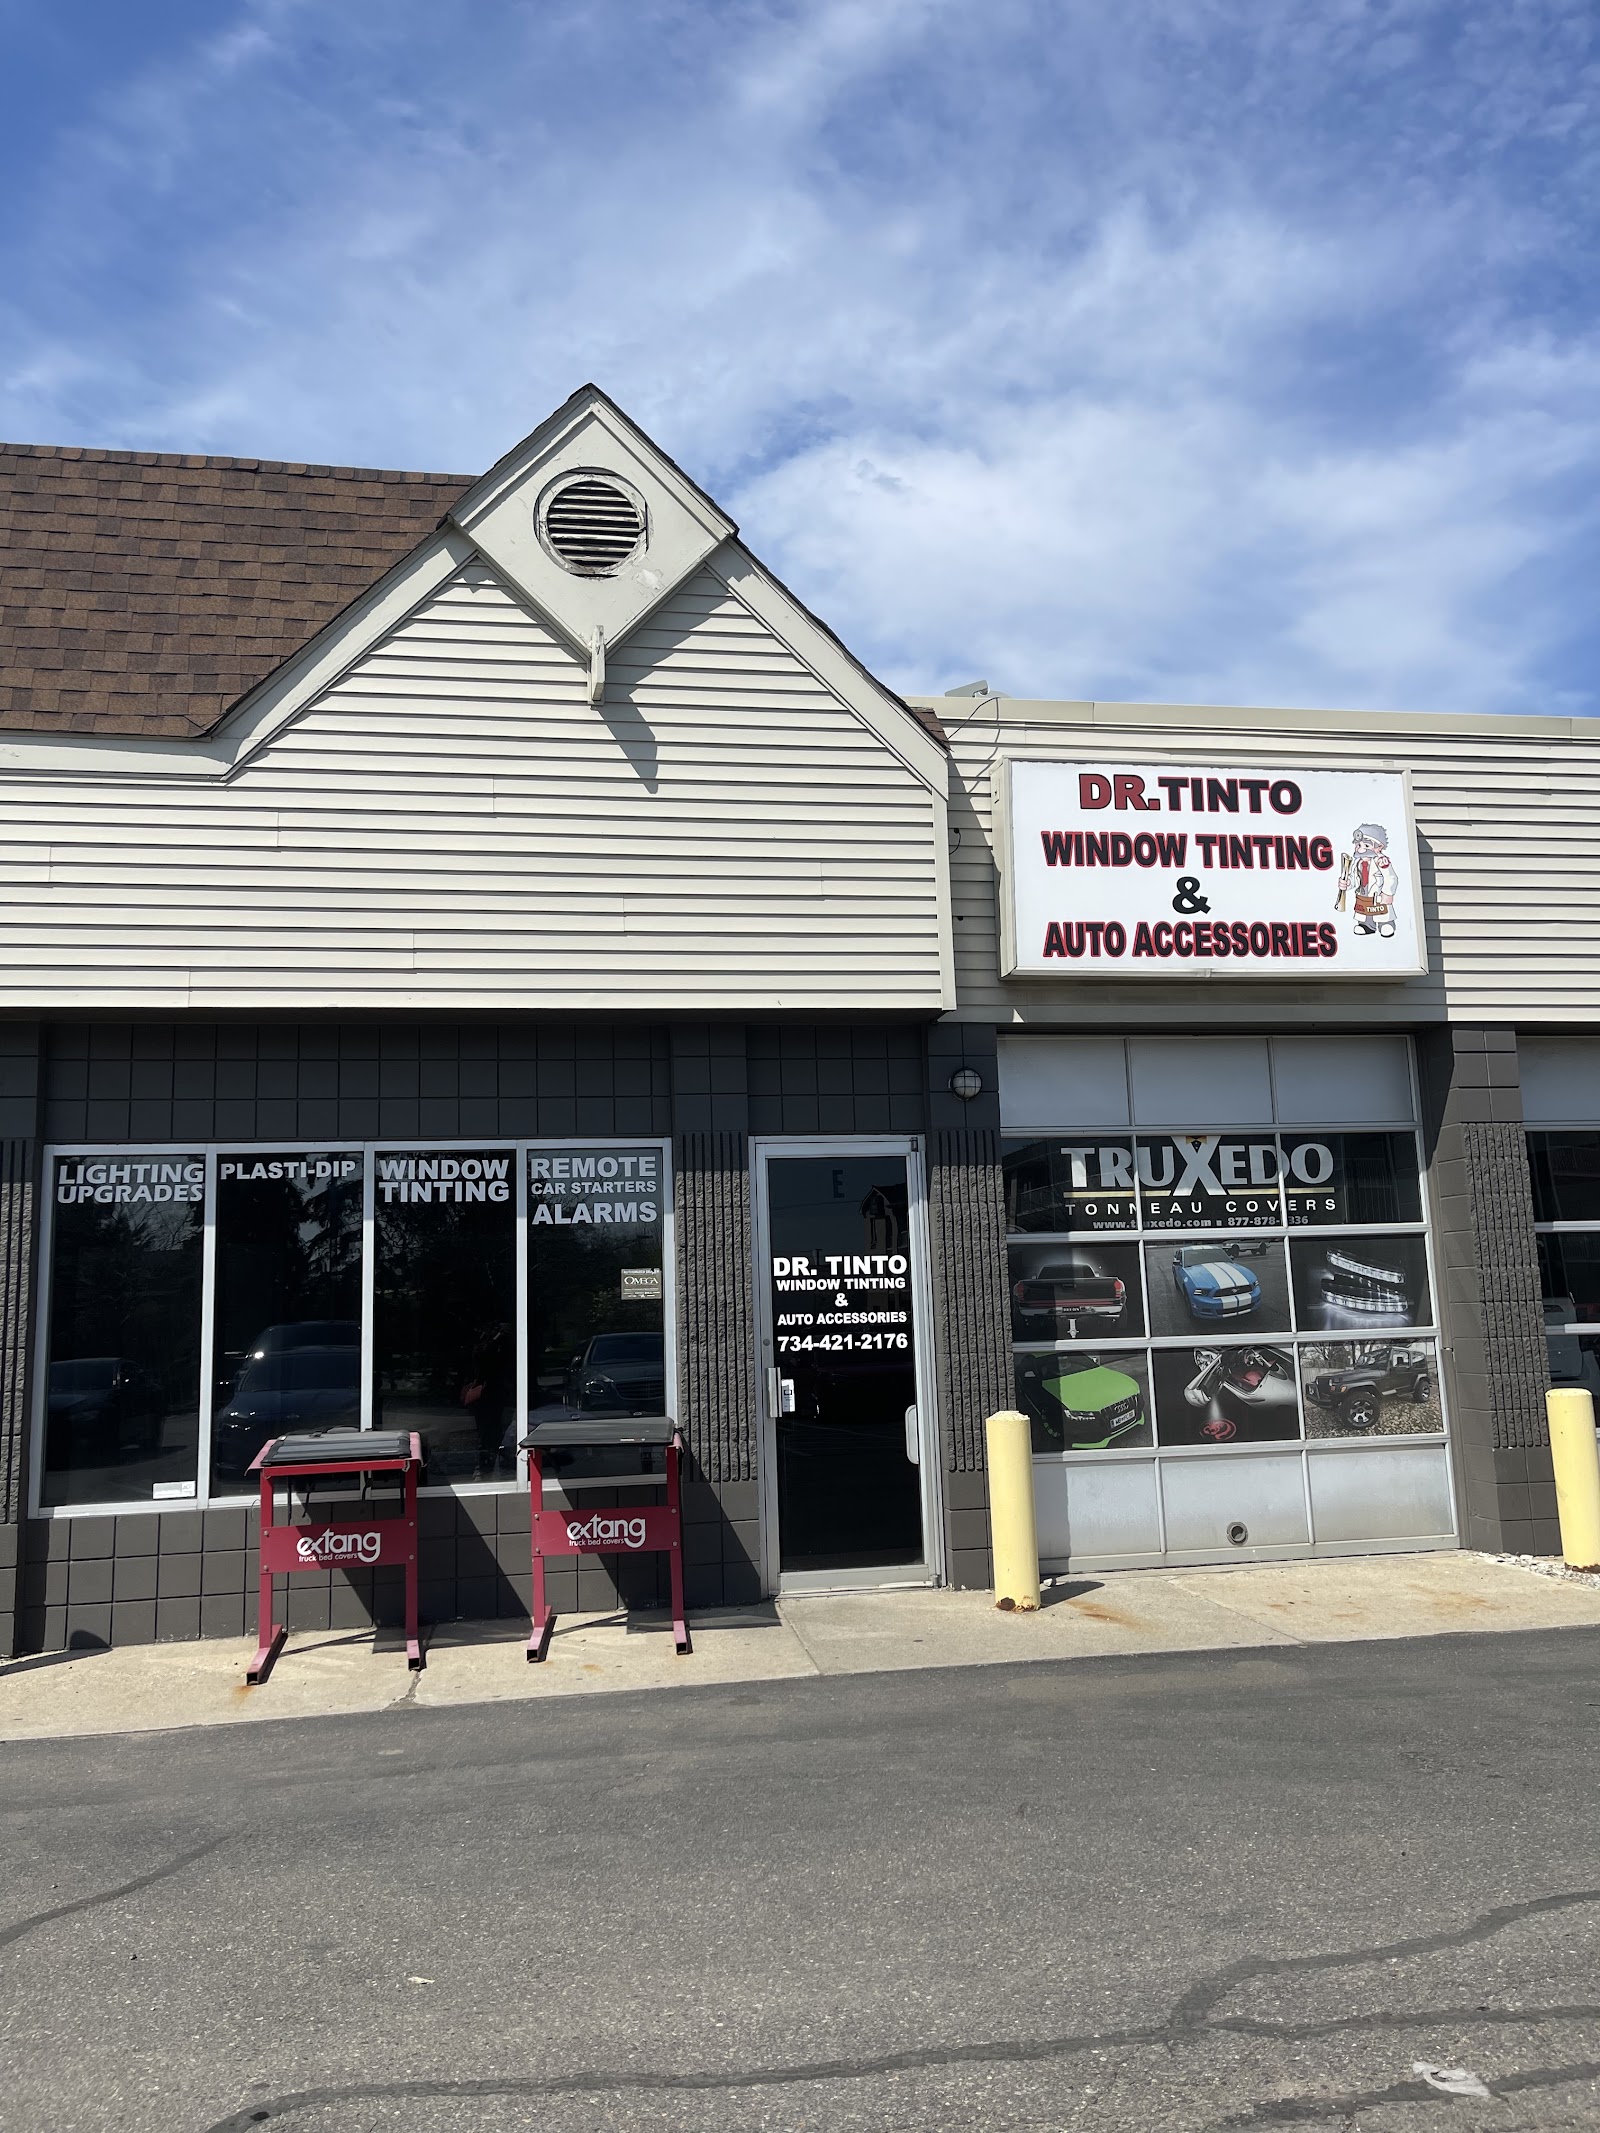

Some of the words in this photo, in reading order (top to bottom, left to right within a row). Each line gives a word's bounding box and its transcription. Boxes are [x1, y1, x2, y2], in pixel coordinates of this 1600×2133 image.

[1041, 831, 1188, 868] WINDOW
[1195, 833, 1334, 870] TINTING
[1172, 876, 1211, 915] &
[1043, 922, 1127, 957] AUTO
[1132, 922, 1338, 958] ACCESSORIES
[58, 1163, 204, 1185] LIGHTING
[220, 1161, 356, 1180] PLASTI-DIP
[379, 1159, 509, 1180] WINDOW
[531, 1156, 657, 1179] REMOTE
[1061, 1136, 1334, 1196] TRUXEDO
[57, 1184, 204, 1203] UPGRADES
[379, 1181, 509, 1203] TINTING
[531, 1182, 566, 1195] CAR
[571, 1181, 657, 1194] STARTERS
[832, 1169, 845, 1198] E
[532, 1202, 658, 1225] ALARMS
[1065, 1201, 1203, 1216] TONNEAU
[1225, 1199, 1336, 1213] COVERS
[1093, 1217, 1212, 1229] www.tuxedo.com
[1227, 1215, 1309, 1226] 877-878-336
[773, 1256, 818, 1277] DR.
[825, 1255, 907, 1275] TINTO
[624, 1275, 659, 1285] OMEGA
[776, 1279, 841, 1291] WINDOW
[844, 1277, 906, 1290] TINTING
[834, 1292, 849, 1307] &
[777, 1313, 814, 1326] AUTO
[816, 1311, 907, 1325] ACCESSORIES
[777, 1333, 909, 1352] 734-421-2176
[566, 1513, 646, 1548] extang
[296, 1528, 381, 1563] extang
[569, 1539, 586, 1547] truck
[587, 1538, 601, 1546] bed
[602, 1537, 625, 1545] covers
[299, 1554, 316, 1562] truck
[318, 1553, 333, 1561] bed
[334, 1552, 358, 1560] covers
